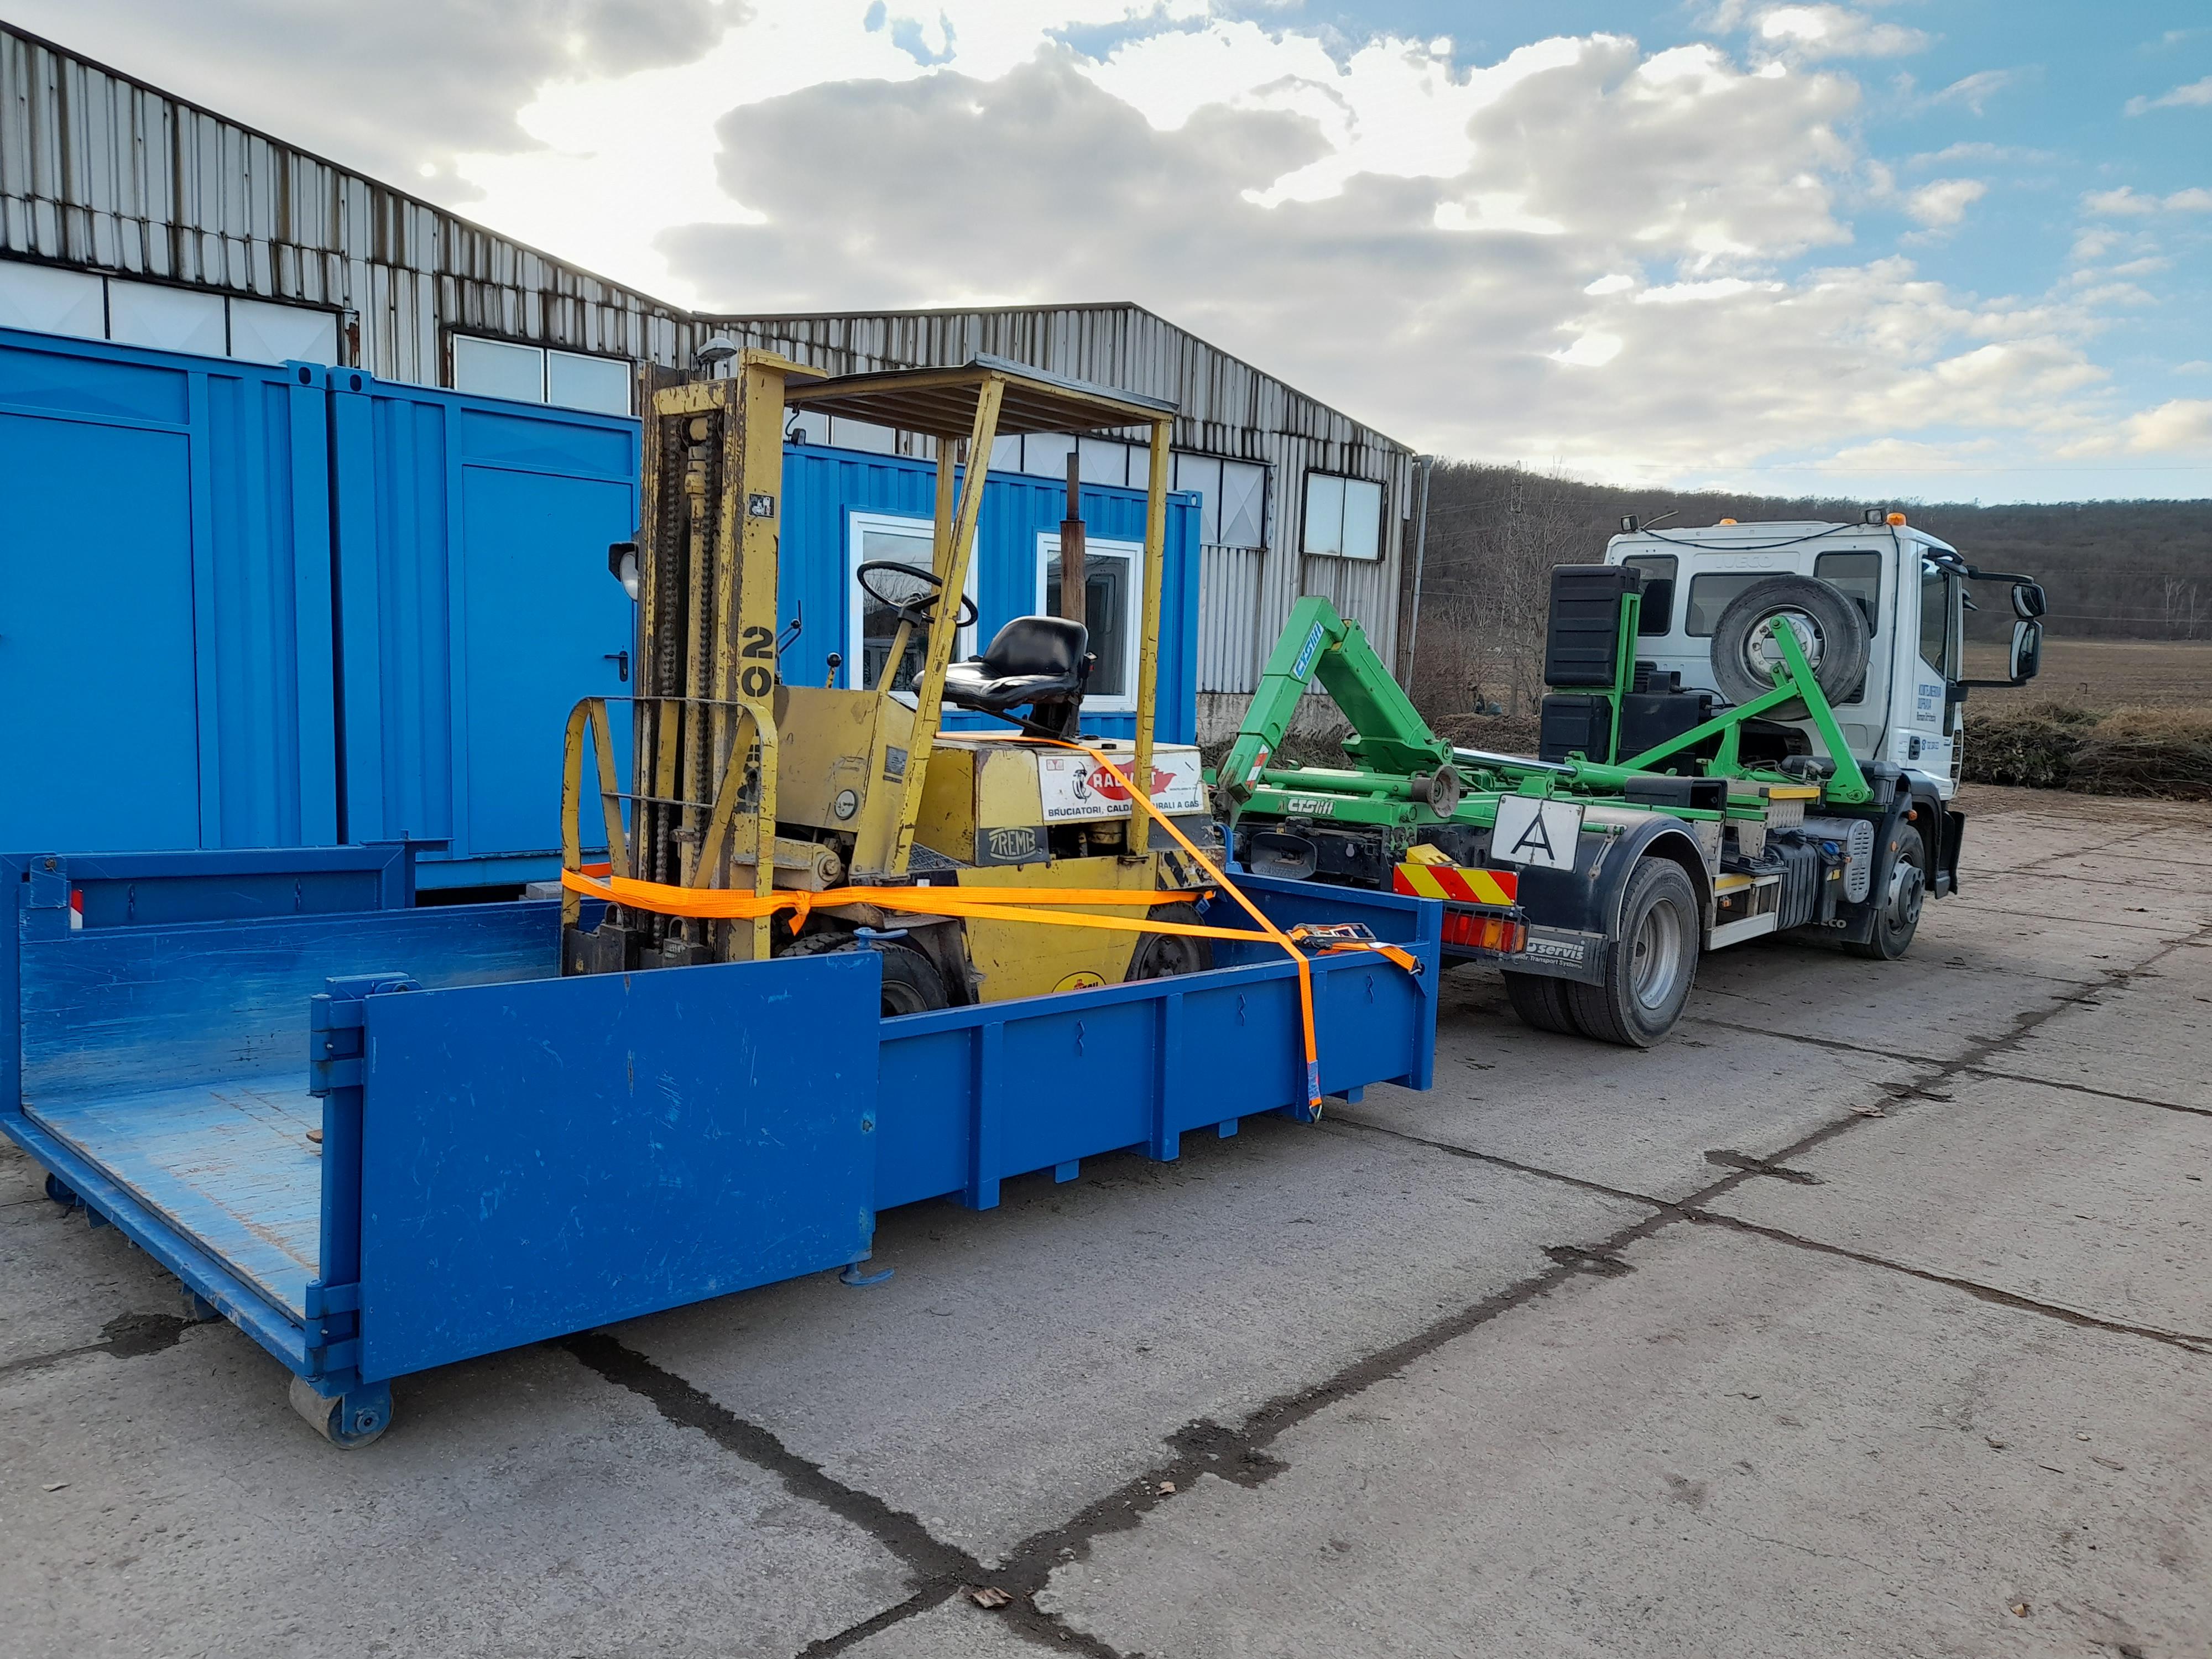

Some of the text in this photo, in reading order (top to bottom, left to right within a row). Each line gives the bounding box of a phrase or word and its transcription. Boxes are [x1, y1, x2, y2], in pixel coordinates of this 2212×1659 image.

[1716, 555, 1774, 568] IVECO
[1048, 806, 1104, 817] BRUCIATORI,
[1510, 812, 1555, 860] A
[1530, 956, 1558, 965] Transport
[1558, 959, 1583, 969] Systems
